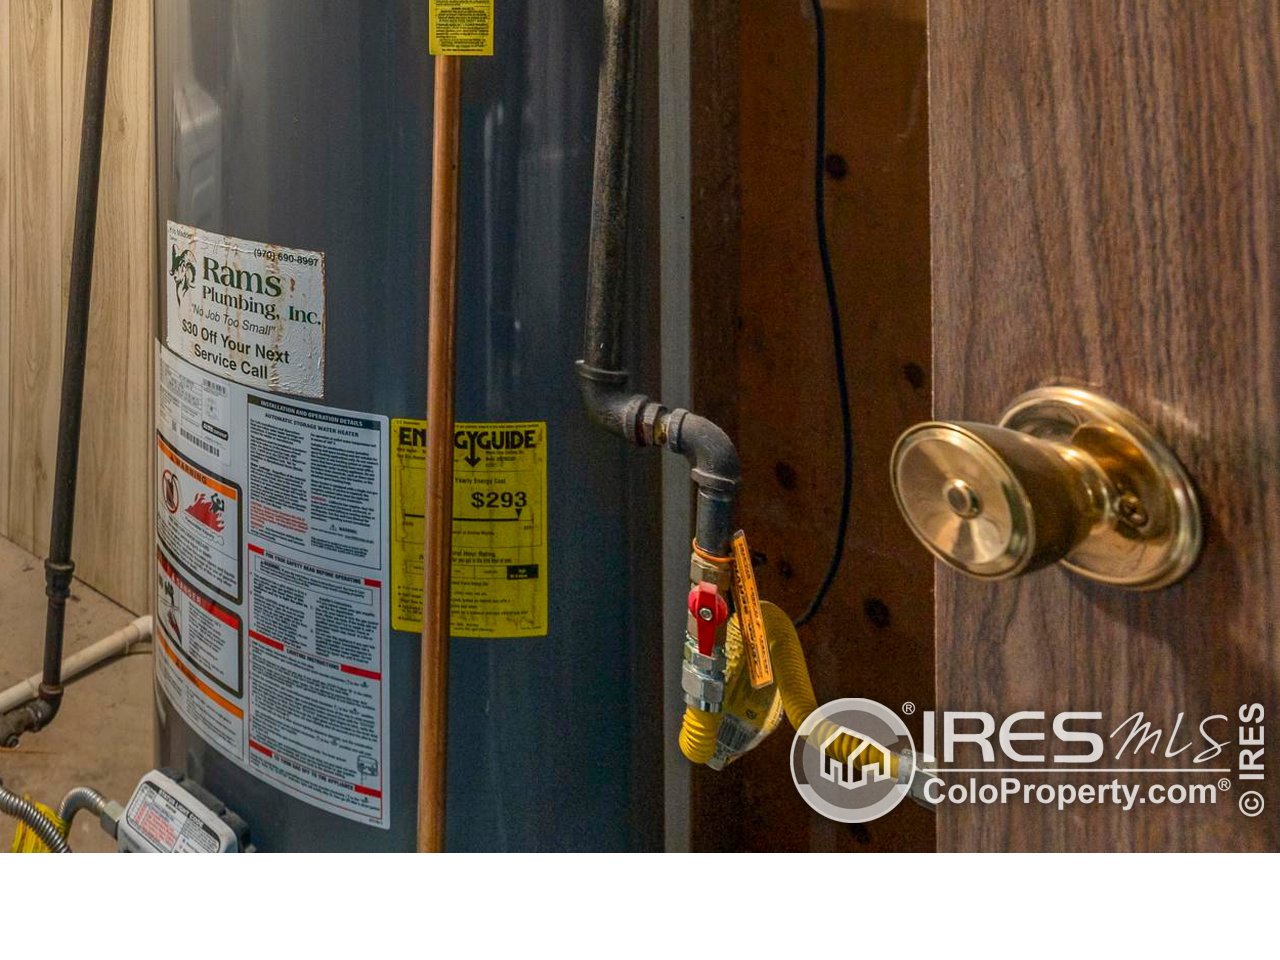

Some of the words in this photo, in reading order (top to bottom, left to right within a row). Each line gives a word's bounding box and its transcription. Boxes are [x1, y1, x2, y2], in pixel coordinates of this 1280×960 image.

[253, 248, 276, 262] (970)
[277, 251, 319, 267] 690-8997
[202, 256, 282, 298] Rams
[202, 285, 280, 320] Plumbing,
[288, 305, 322, 325] Inc.
[205, 308, 220, 323] Job
[223, 314, 239, 329] Too
[241, 319, 276, 336] Small"
[181, 318, 198, 338] $30
[200, 327, 218, 345] Off
[220, 333, 251, 355] Your
[255, 343, 290, 364] Next
[193, 343, 237, 372] Service
[240, 360, 268, 380] Call
[260, 399, 296, 414] INSTALLATION
[296, 407, 307, 417] AND
[308, 410, 339, 424] OPERATION
[339, 418, 363, 428] DETAILS
[265, 412, 293, 425] AUTOMATIC
[293, 419, 317, 431] STORAGE
[317, 425, 336, 434] WATER
[337, 428, 359, 438] HEATER
[399, 427, 536, 450] ENGYGUIDE
[471, 491, 527, 510] $293
